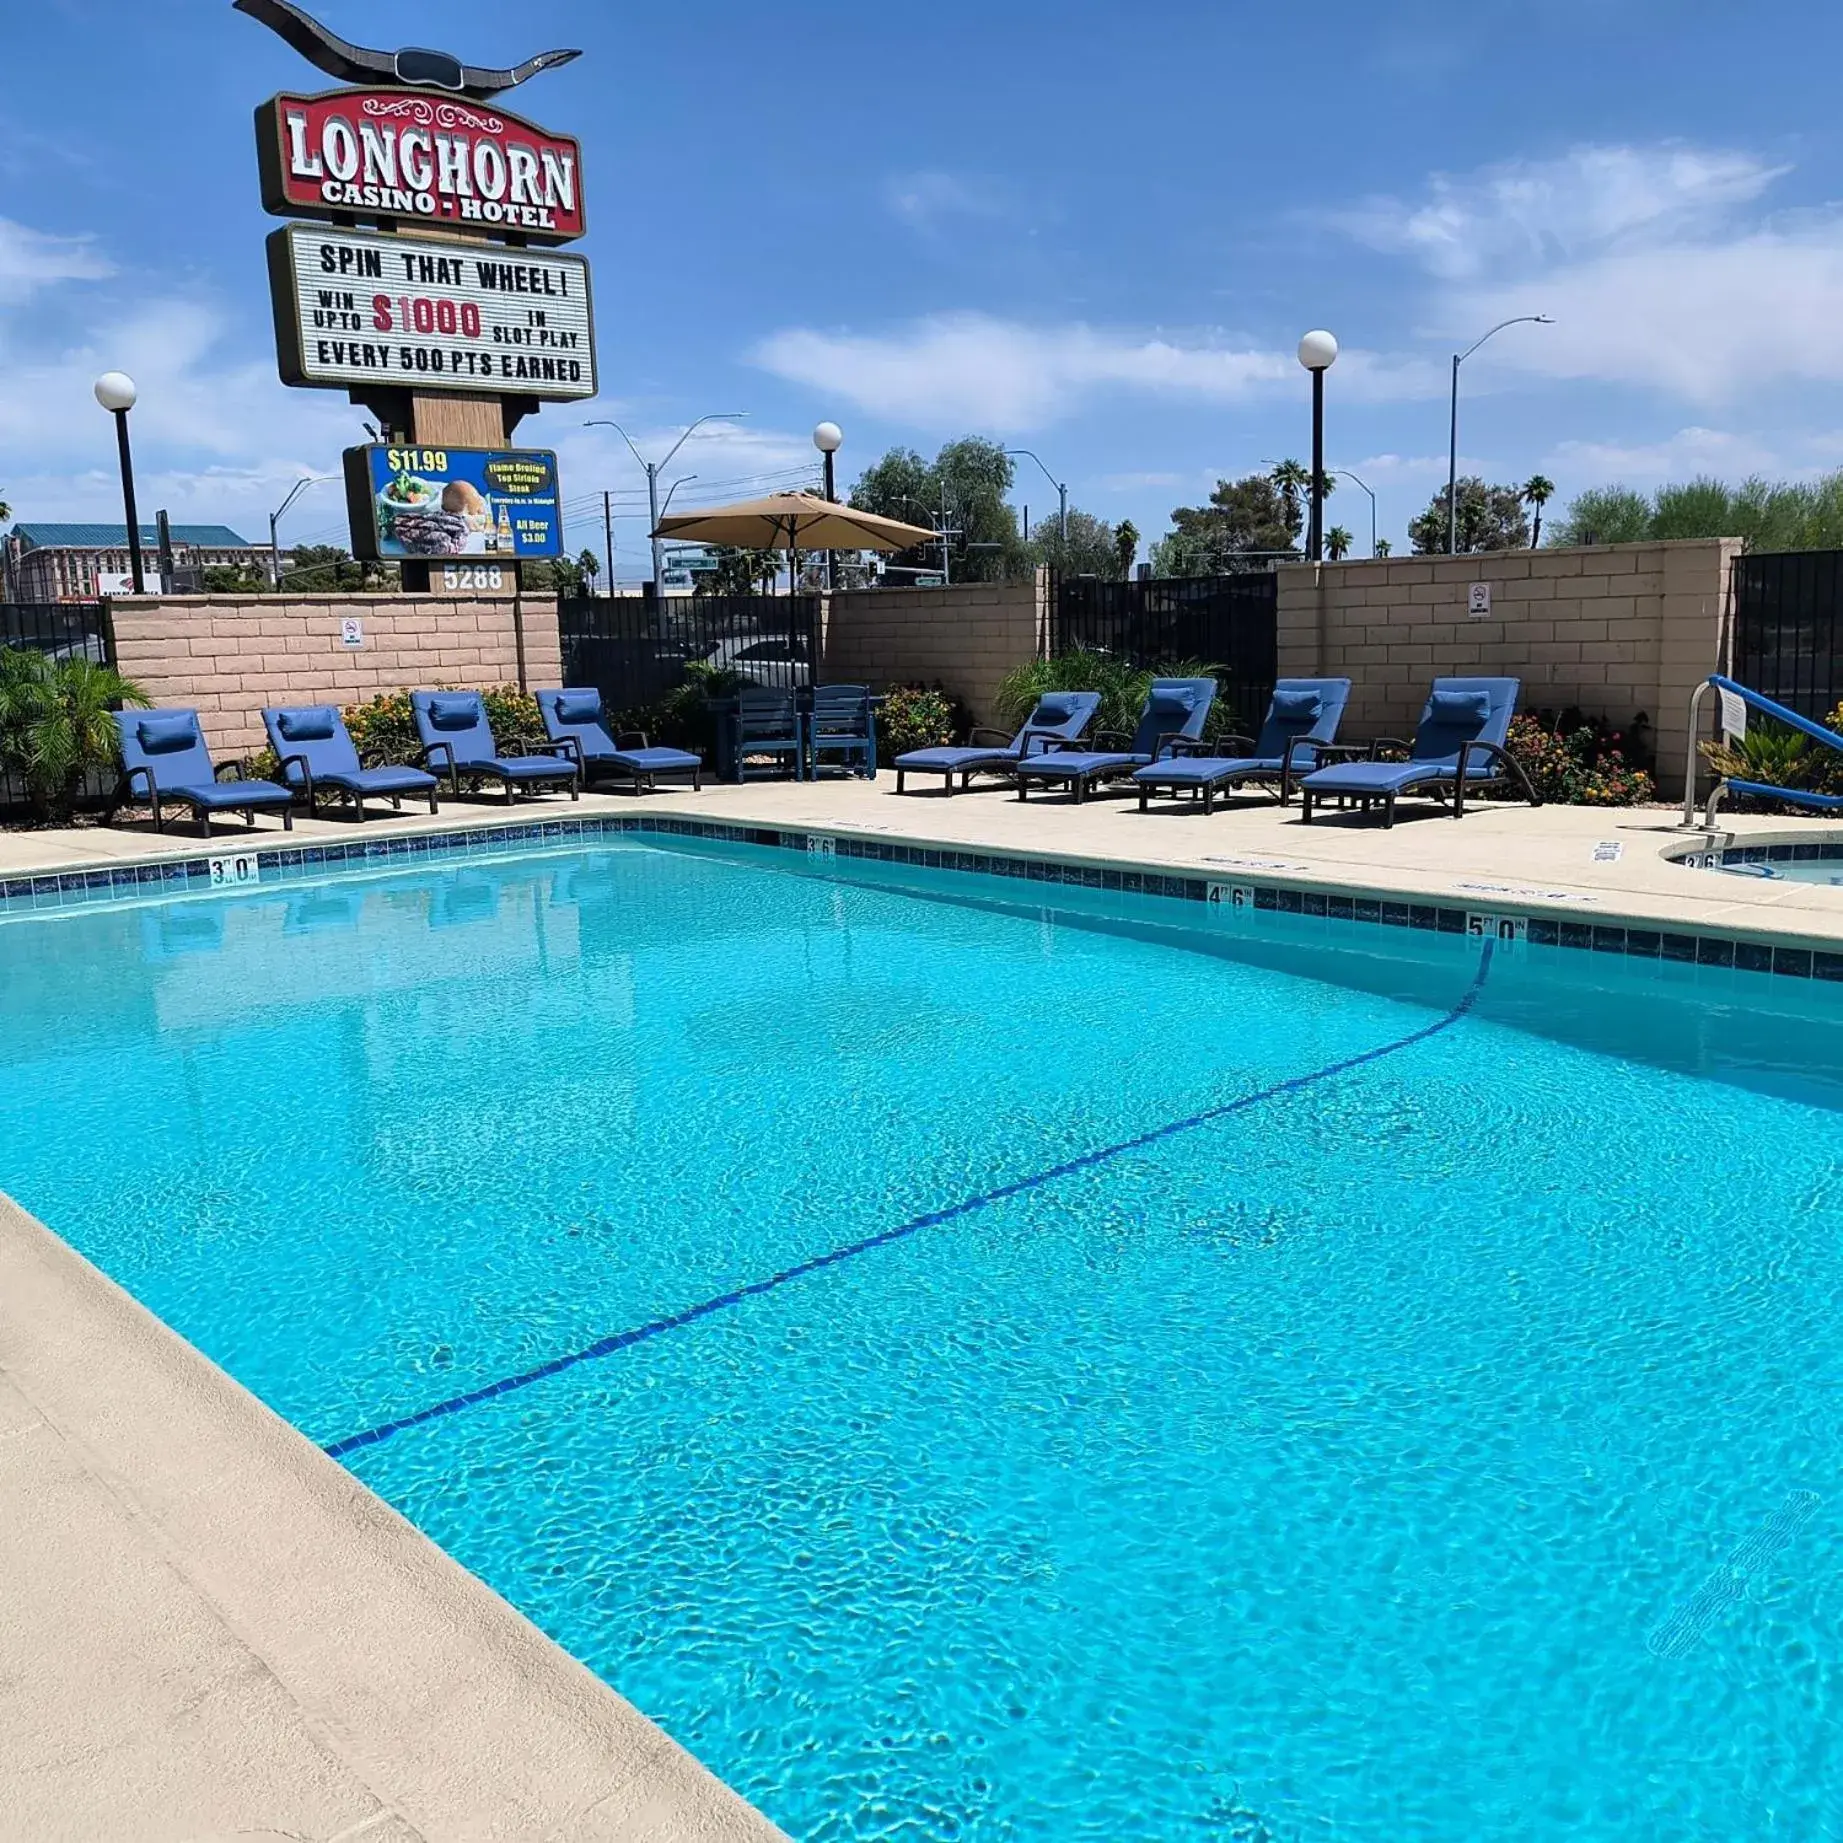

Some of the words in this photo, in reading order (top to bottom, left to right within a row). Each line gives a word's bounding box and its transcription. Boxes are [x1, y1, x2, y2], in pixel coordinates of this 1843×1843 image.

[286, 108, 576, 211] LONGHORN
[321, 180, 436, 214] CASINO
[461, 198, 556, 229] HOTEL
[320, 244, 382, 279] SPIN
[401, 253, 464, 286] THAT
[317, 289, 354, 310] WIN
[528, 310, 546, 328] IN
[492, 326, 532, 345] SLOT
[540, 329, 578, 349] PLAY
[317, 341, 390, 368] EVERY
[400, 347, 443, 372] 500
[451, 351, 492, 377] PTS
[501, 355, 580, 382] EARNED
[387, 449, 448, 472] $11.99
[443, 564, 502, 589] 5288
[212, 861, 224, 882] 3
[236, 858, 248, 880] 0
[1209, 886, 1221, 903] 4
[1469, 916, 1483, 936] 5
[1498, 919, 1514, 940] 0
